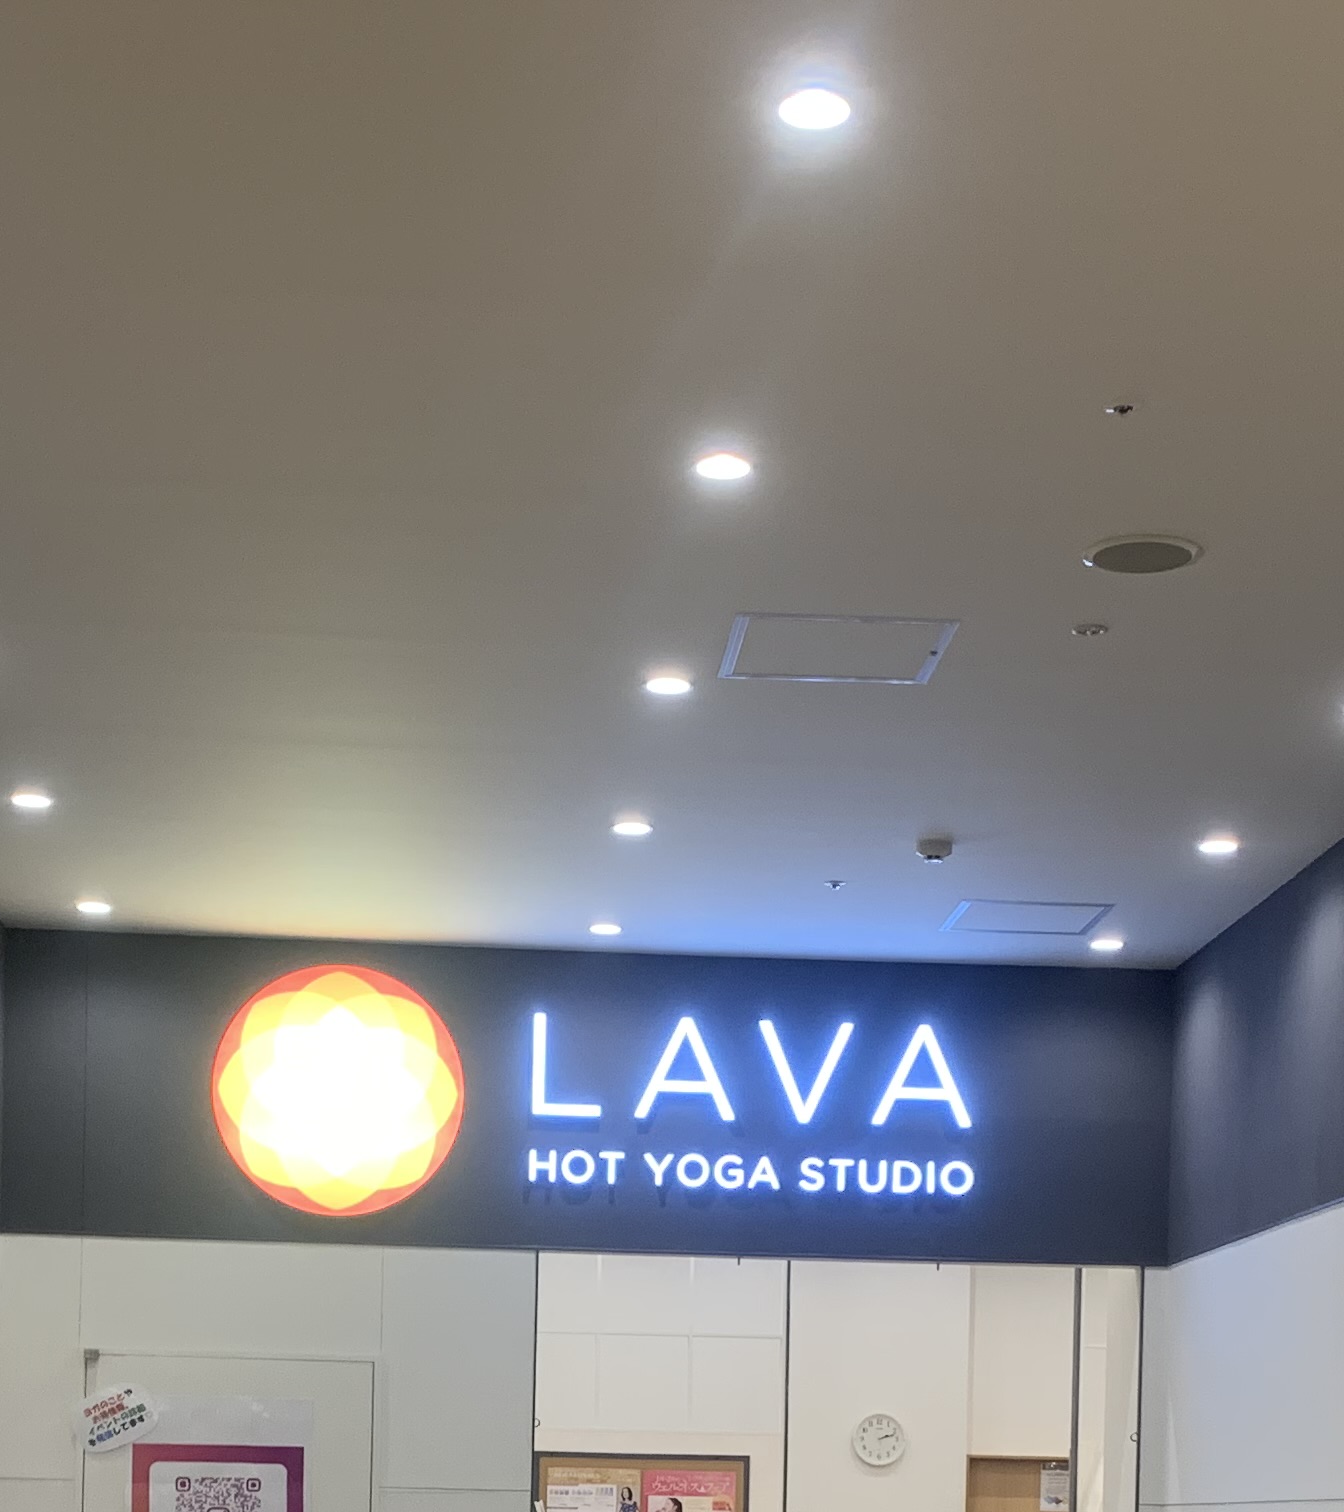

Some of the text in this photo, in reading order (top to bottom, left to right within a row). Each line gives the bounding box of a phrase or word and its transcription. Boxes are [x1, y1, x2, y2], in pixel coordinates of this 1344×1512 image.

[532, 1012, 972, 1128] LAVA
[528, 1149, 975, 1195] HOT YOGA STUDIO
